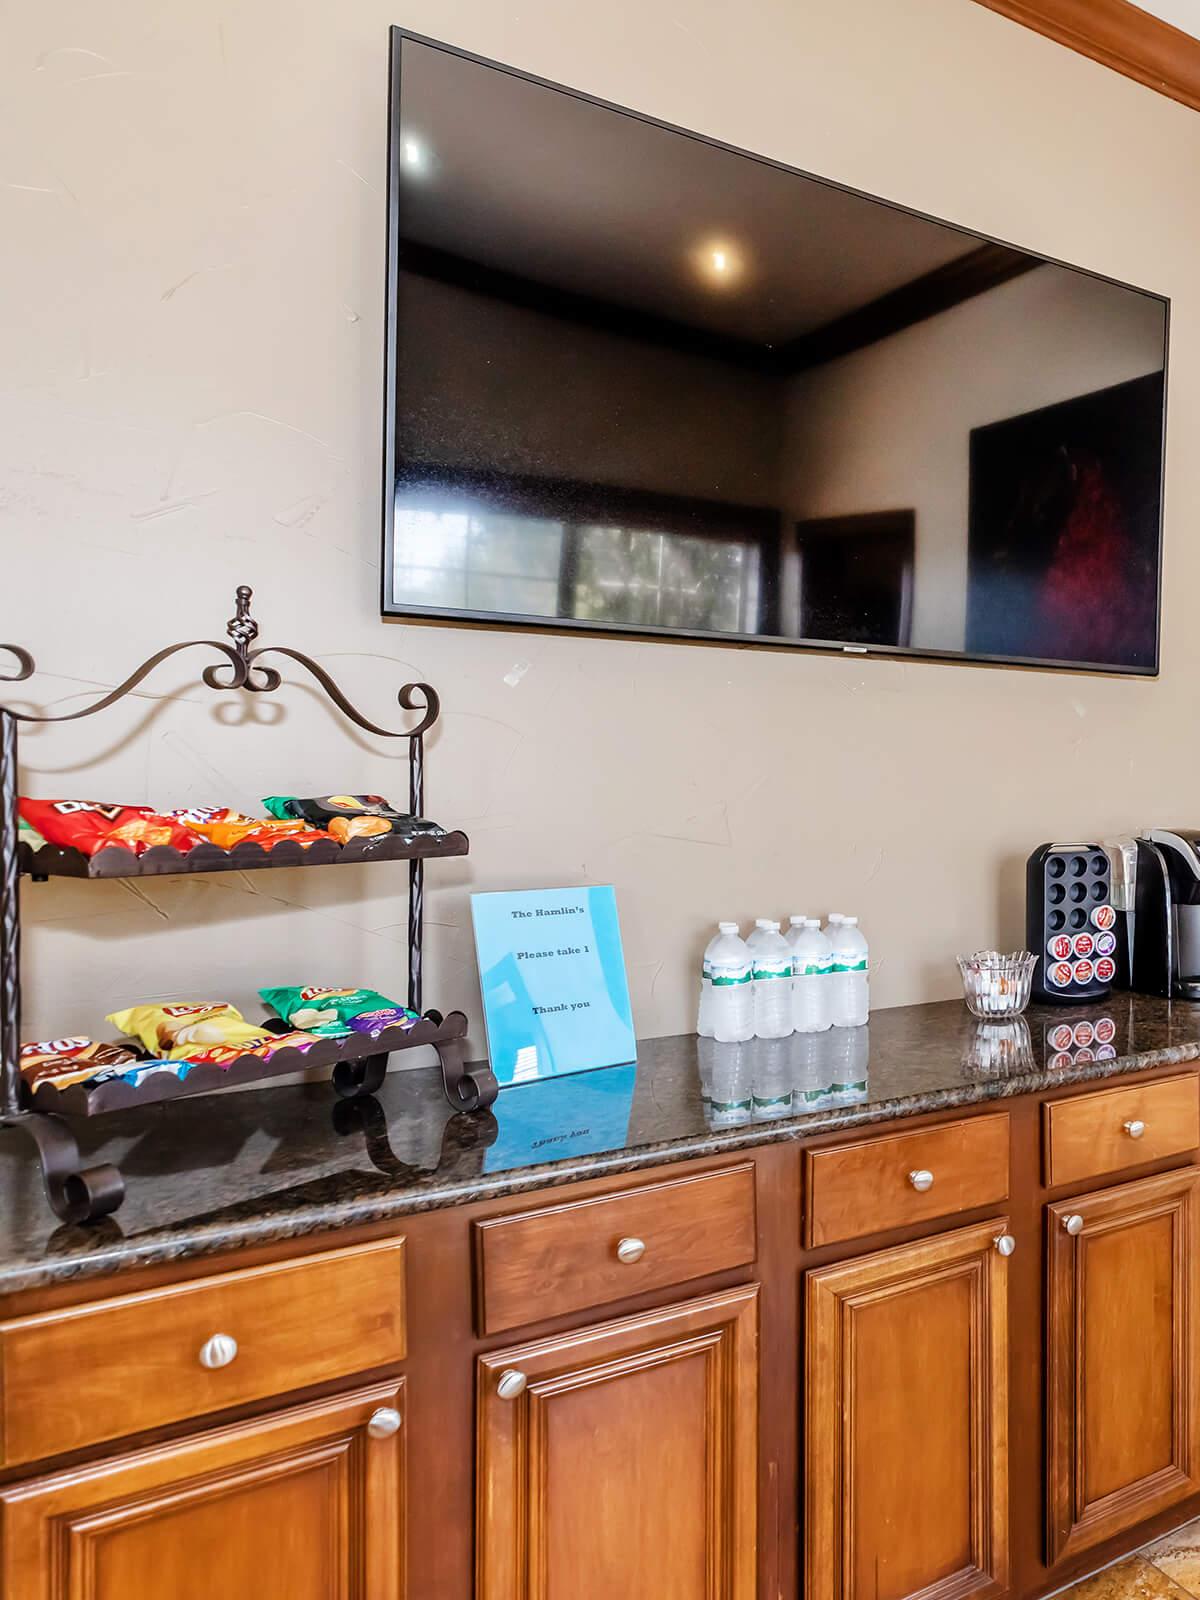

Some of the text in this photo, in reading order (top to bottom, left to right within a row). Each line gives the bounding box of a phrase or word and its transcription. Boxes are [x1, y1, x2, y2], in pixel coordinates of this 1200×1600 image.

[511, 906, 584, 919] The Hamlin's
[517, 951, 554, 960] Please
[556, 947, 581, 956] take
[532, 1001, 591, 1015] Thank you
